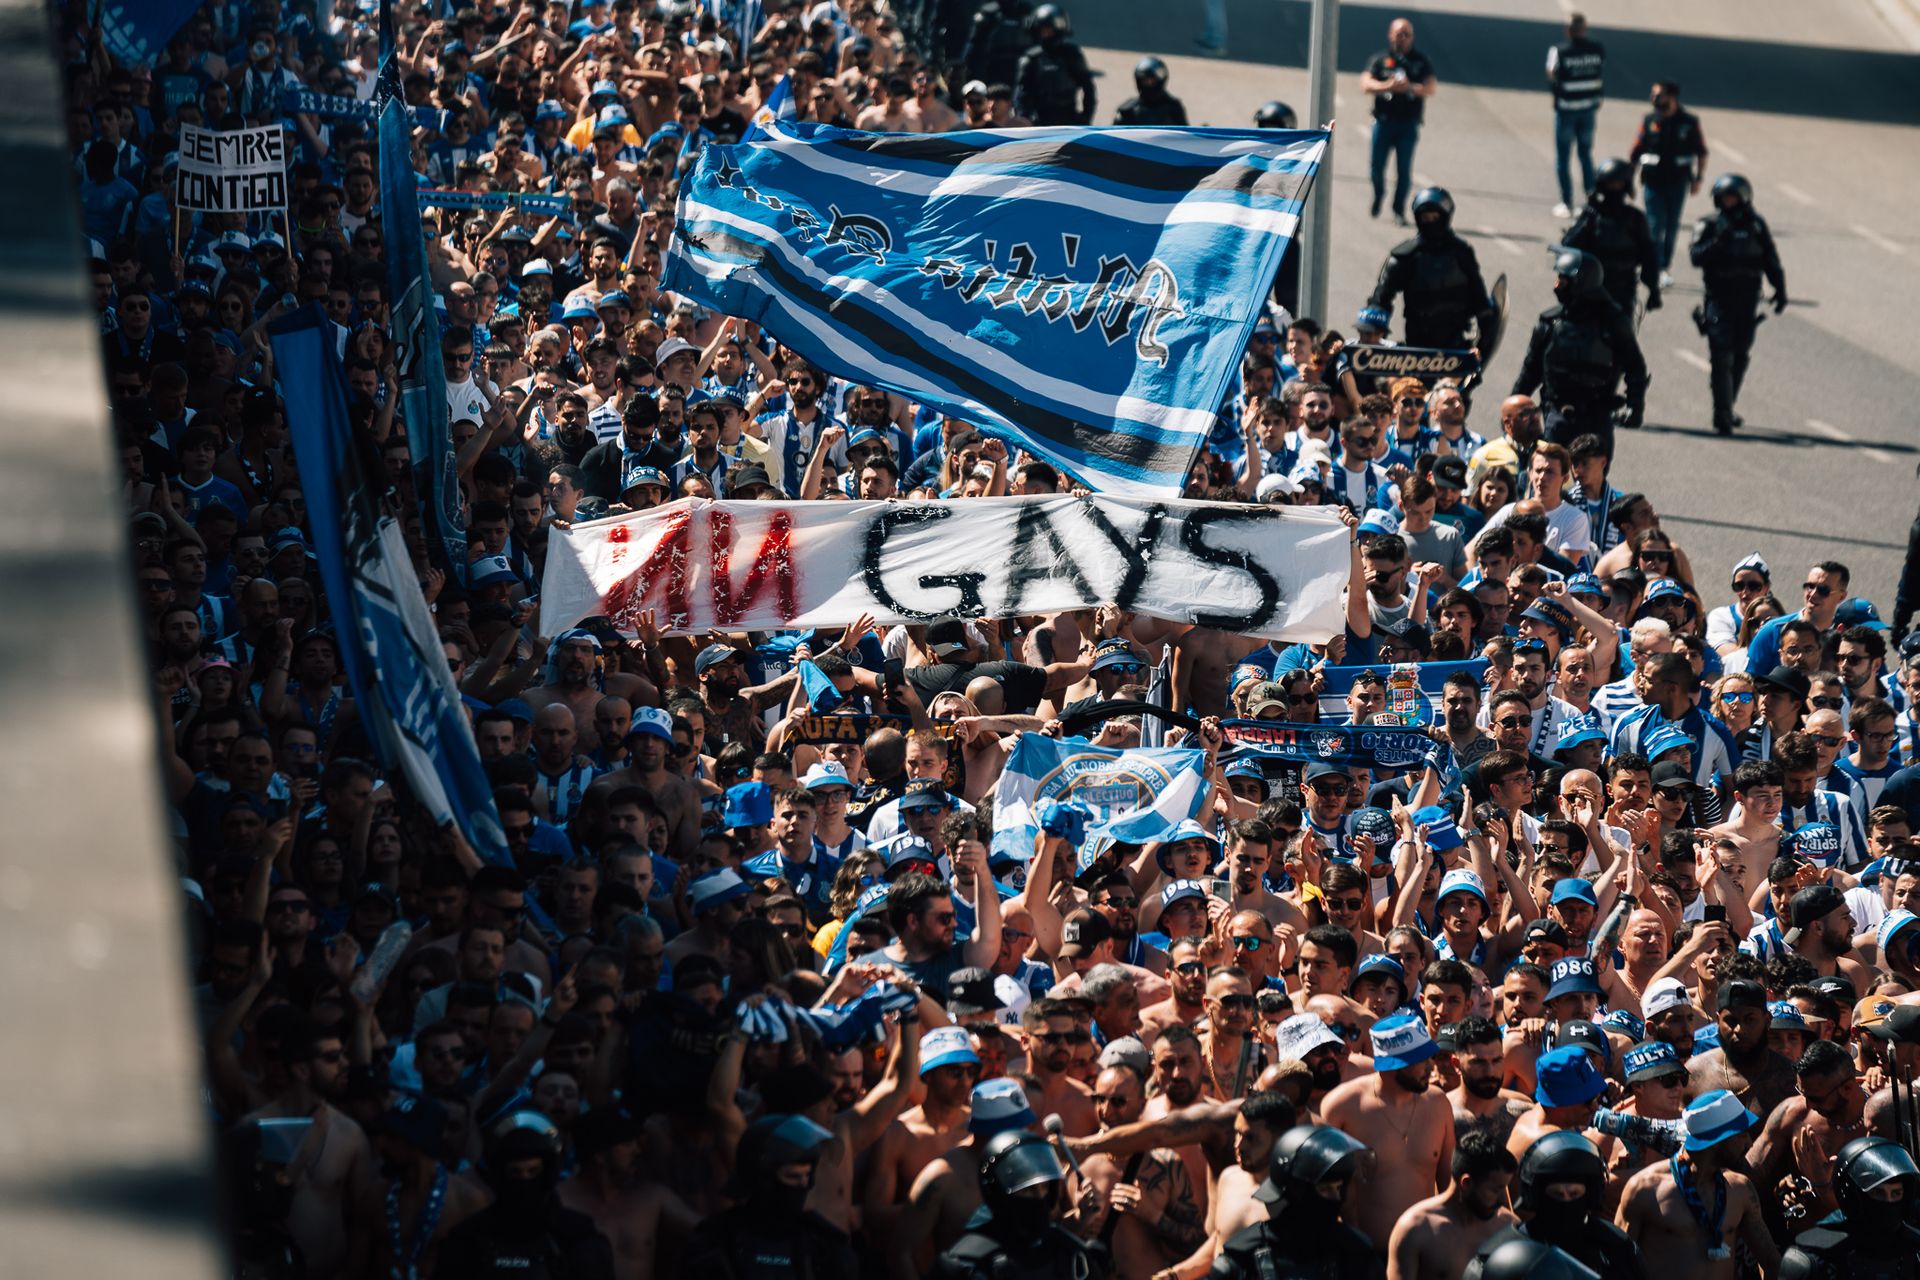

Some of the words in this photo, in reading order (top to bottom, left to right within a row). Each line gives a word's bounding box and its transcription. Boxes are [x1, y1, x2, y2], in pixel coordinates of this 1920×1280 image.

[183, 128, 282, 165] SEMPRE
[862, 504, 1284, 632] GAYS
[1123, 759, 1165, 790] SEMPRE
[1552, 960, 1593, 983] 1986
